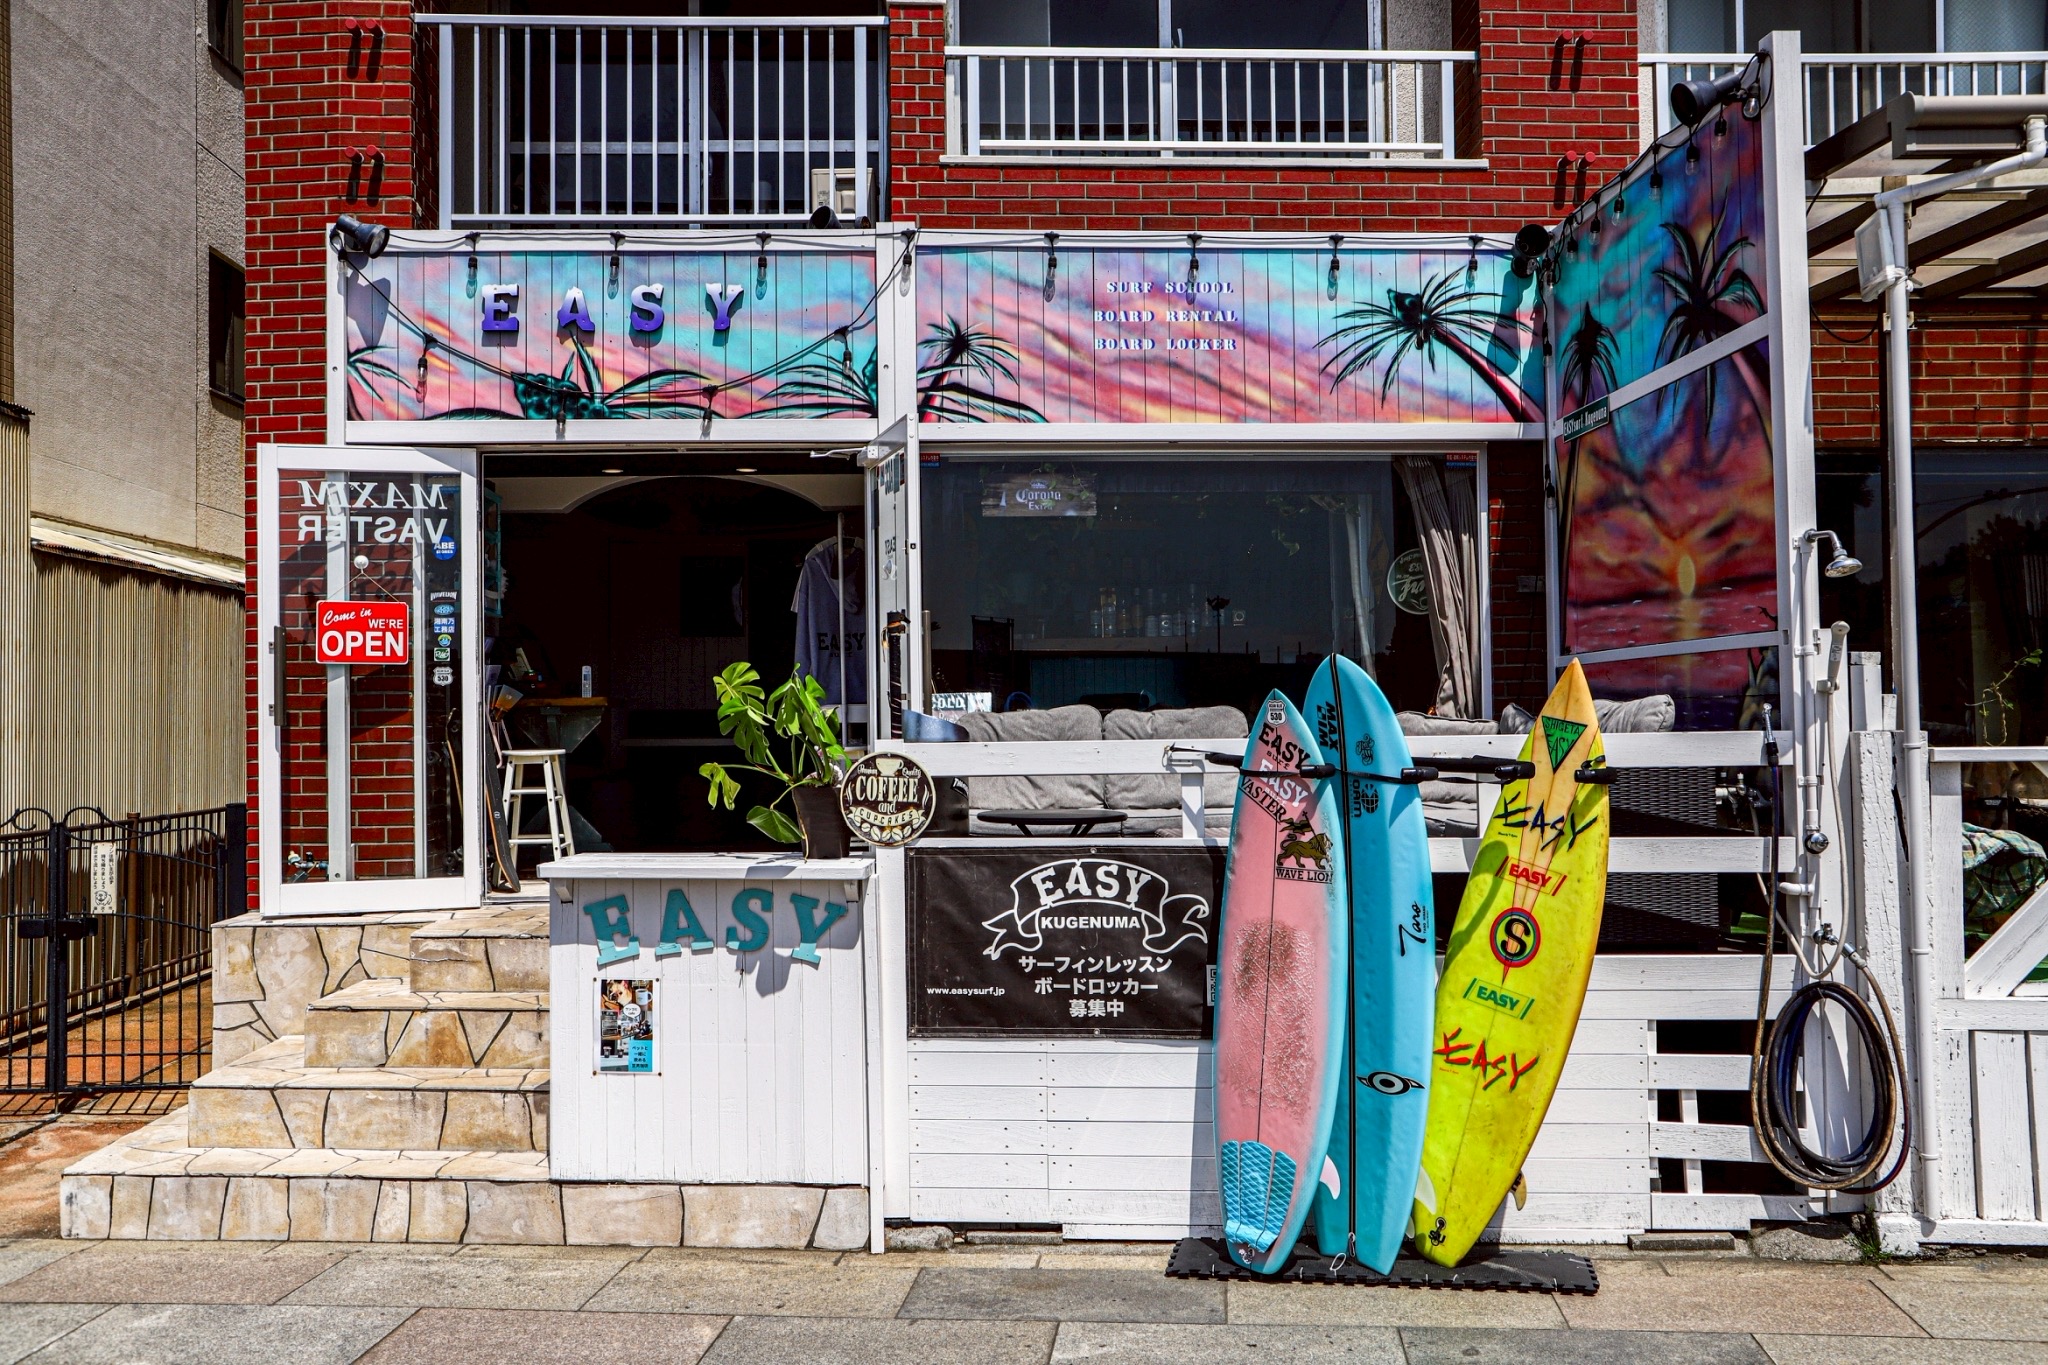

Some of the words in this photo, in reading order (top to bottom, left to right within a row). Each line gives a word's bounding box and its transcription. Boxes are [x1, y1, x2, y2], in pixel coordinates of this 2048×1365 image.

[1106, 281, 1154, 294] SURF
[1165, 281, 1234, 294] SCHOOL
[481, 283, 744, 331] EASY
[1094, 310, 1155, 323] BOARD
[1166, 310, 1238, 323] RENTAL
[1095, 338, 1156, 351] BOARD
[1166, 338, 1237, 351] LOCKER
[1015, 488, 1062, 504] Corona
[323, 609, 356, 626] Come
[360, 608, 372, 617] in
[368, 618, 404, 629] WE'RE
[321, 630, 404, 657] OPEN
[1270, 712, 1283, 722] 530
[1543, 716, 1582, 736] SHIGETA
[1258, 722, 1311, 770] EASY
[1547, 733, 1575, 764] EASY
[855, 775, 919, 803] COFFEE
[878, 795, 898, 815] and
[859, 808, 914, 825] CUPCAKES
[1493, 791, 1599, 852] EASY
[1276, 866, 1303, 880] WAVE
[1507, 862, 1553, 888] EASY
[1031, 861, 1151, 906] EASY
[583, 888, 848, 965] EASY
[1041, 916, 1141, 929] KUGENUMA
[1398, 901, 1427, 957] Taro
[1018, 956, 1173, 974] サーフィンレッスン
[926, 986, 1005, 997] www.easysurf.jp
[1034, 977, 1159, 996] ボードロッカー
[1476, 985, 1521, 1011] EASY
[1068, 999, 1125, 1018] 募集中
[1433, 1027, 1541, 1093] EASY
